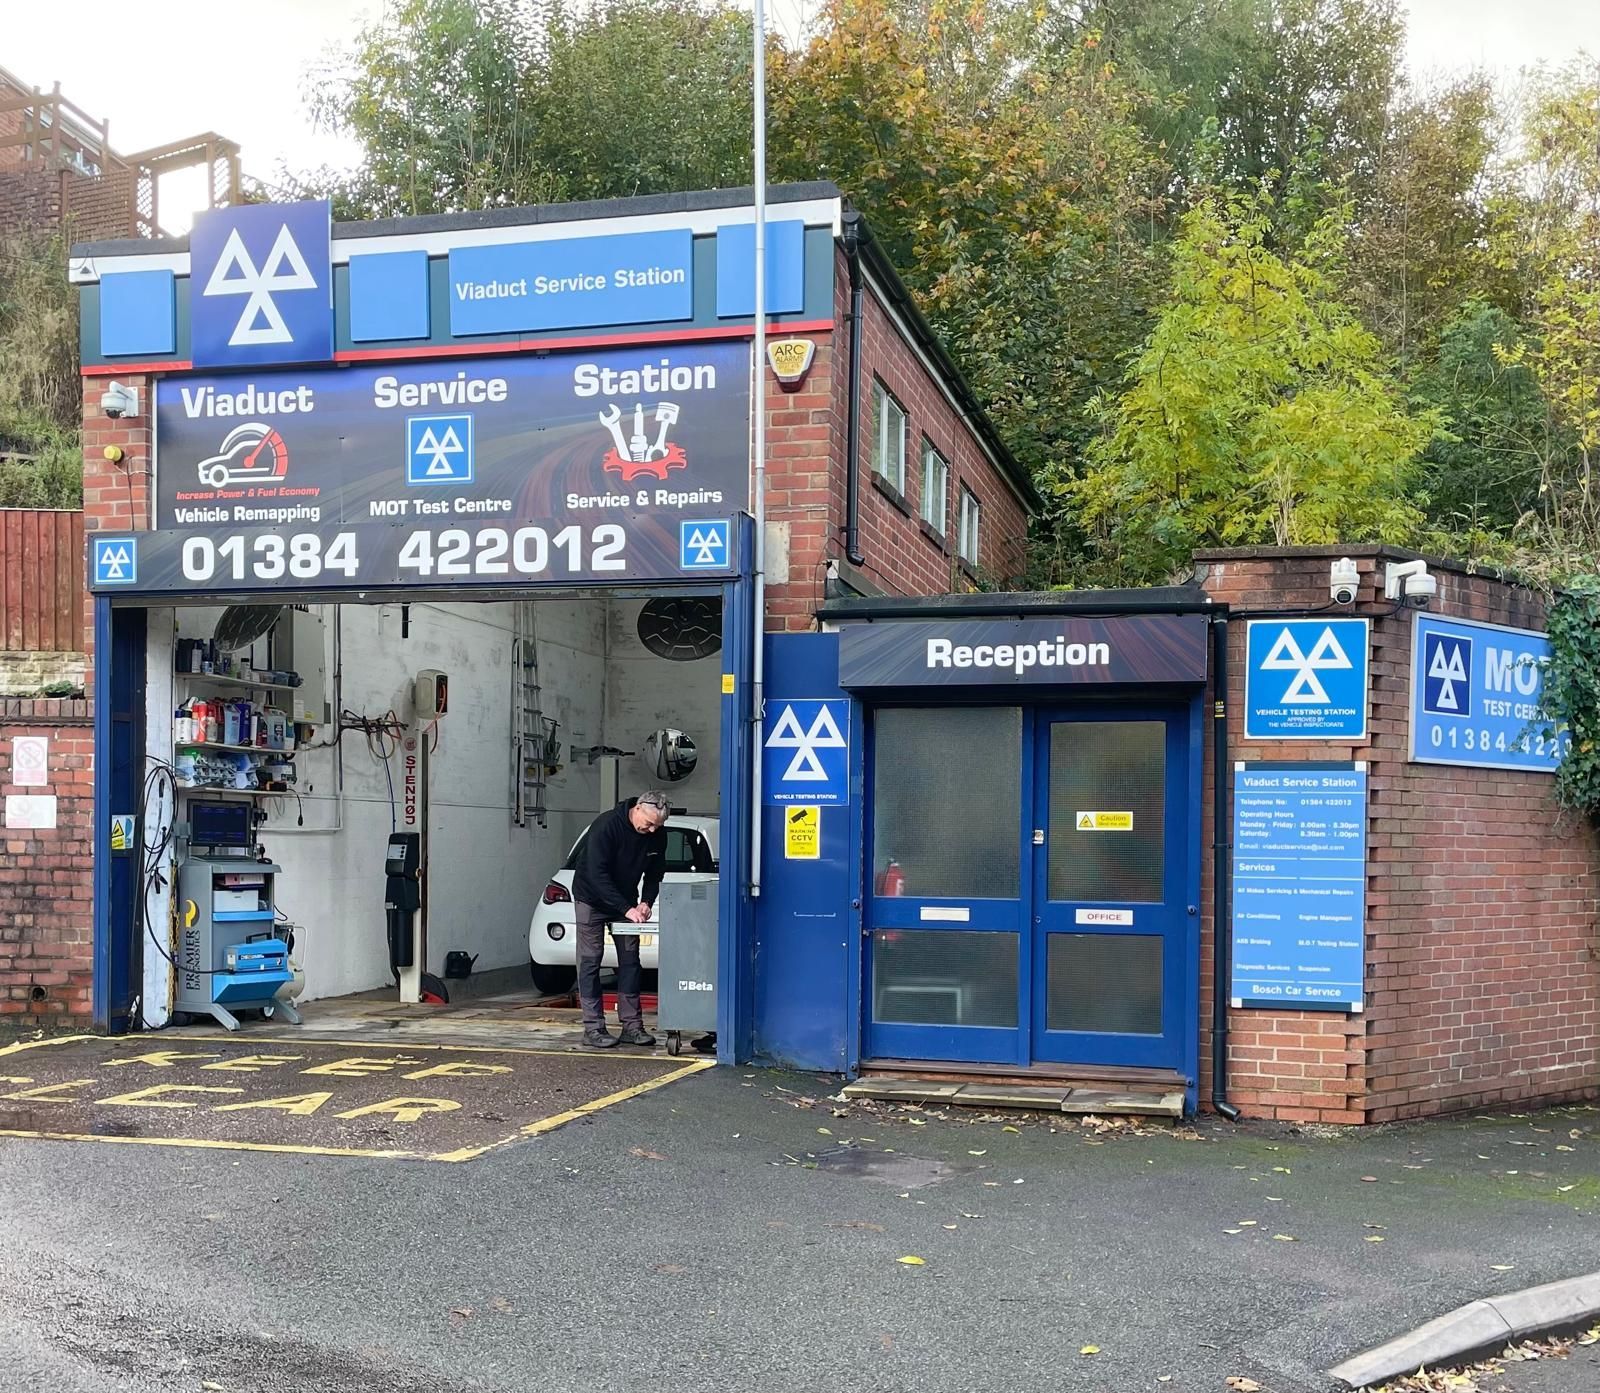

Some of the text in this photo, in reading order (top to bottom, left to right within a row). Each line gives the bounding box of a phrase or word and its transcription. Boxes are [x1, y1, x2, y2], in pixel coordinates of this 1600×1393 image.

[456, 267, 685, 301] Viaduct Service Station
[775, 344, 805, 356] ARC
[181, 358, 716, 418] Viaduct Service Station
[176, 486, 320, 500] Increase Power & Fuel Economy
[566, 488, 722, 509] Service & Repairs
[174, 505, 320, 524] Vehicle Remapping
[370, 497, 512, 516] MOT Test Centre
[181, 524, 627, 580] 01384 422012
[927, 636, 1110, 674] Reception
[1483, 700, 1512, 718] TEST
[1432, 725, 1506, 752] 01384
[405, 755, 416, 825] STENHØJ
[1244, 778, 1357, 787] Viaduct Service Station
[1240, 811, 1272, 819] Operating
[1239, 863, 1276, 872] Services
[186, 930, 196, 990] PREMIER
[688, 981, 713, 990] Beta
[1252, 985, 1342, 996] Bosch Car Service
[100, 1051, 514, 1080] KEEP
